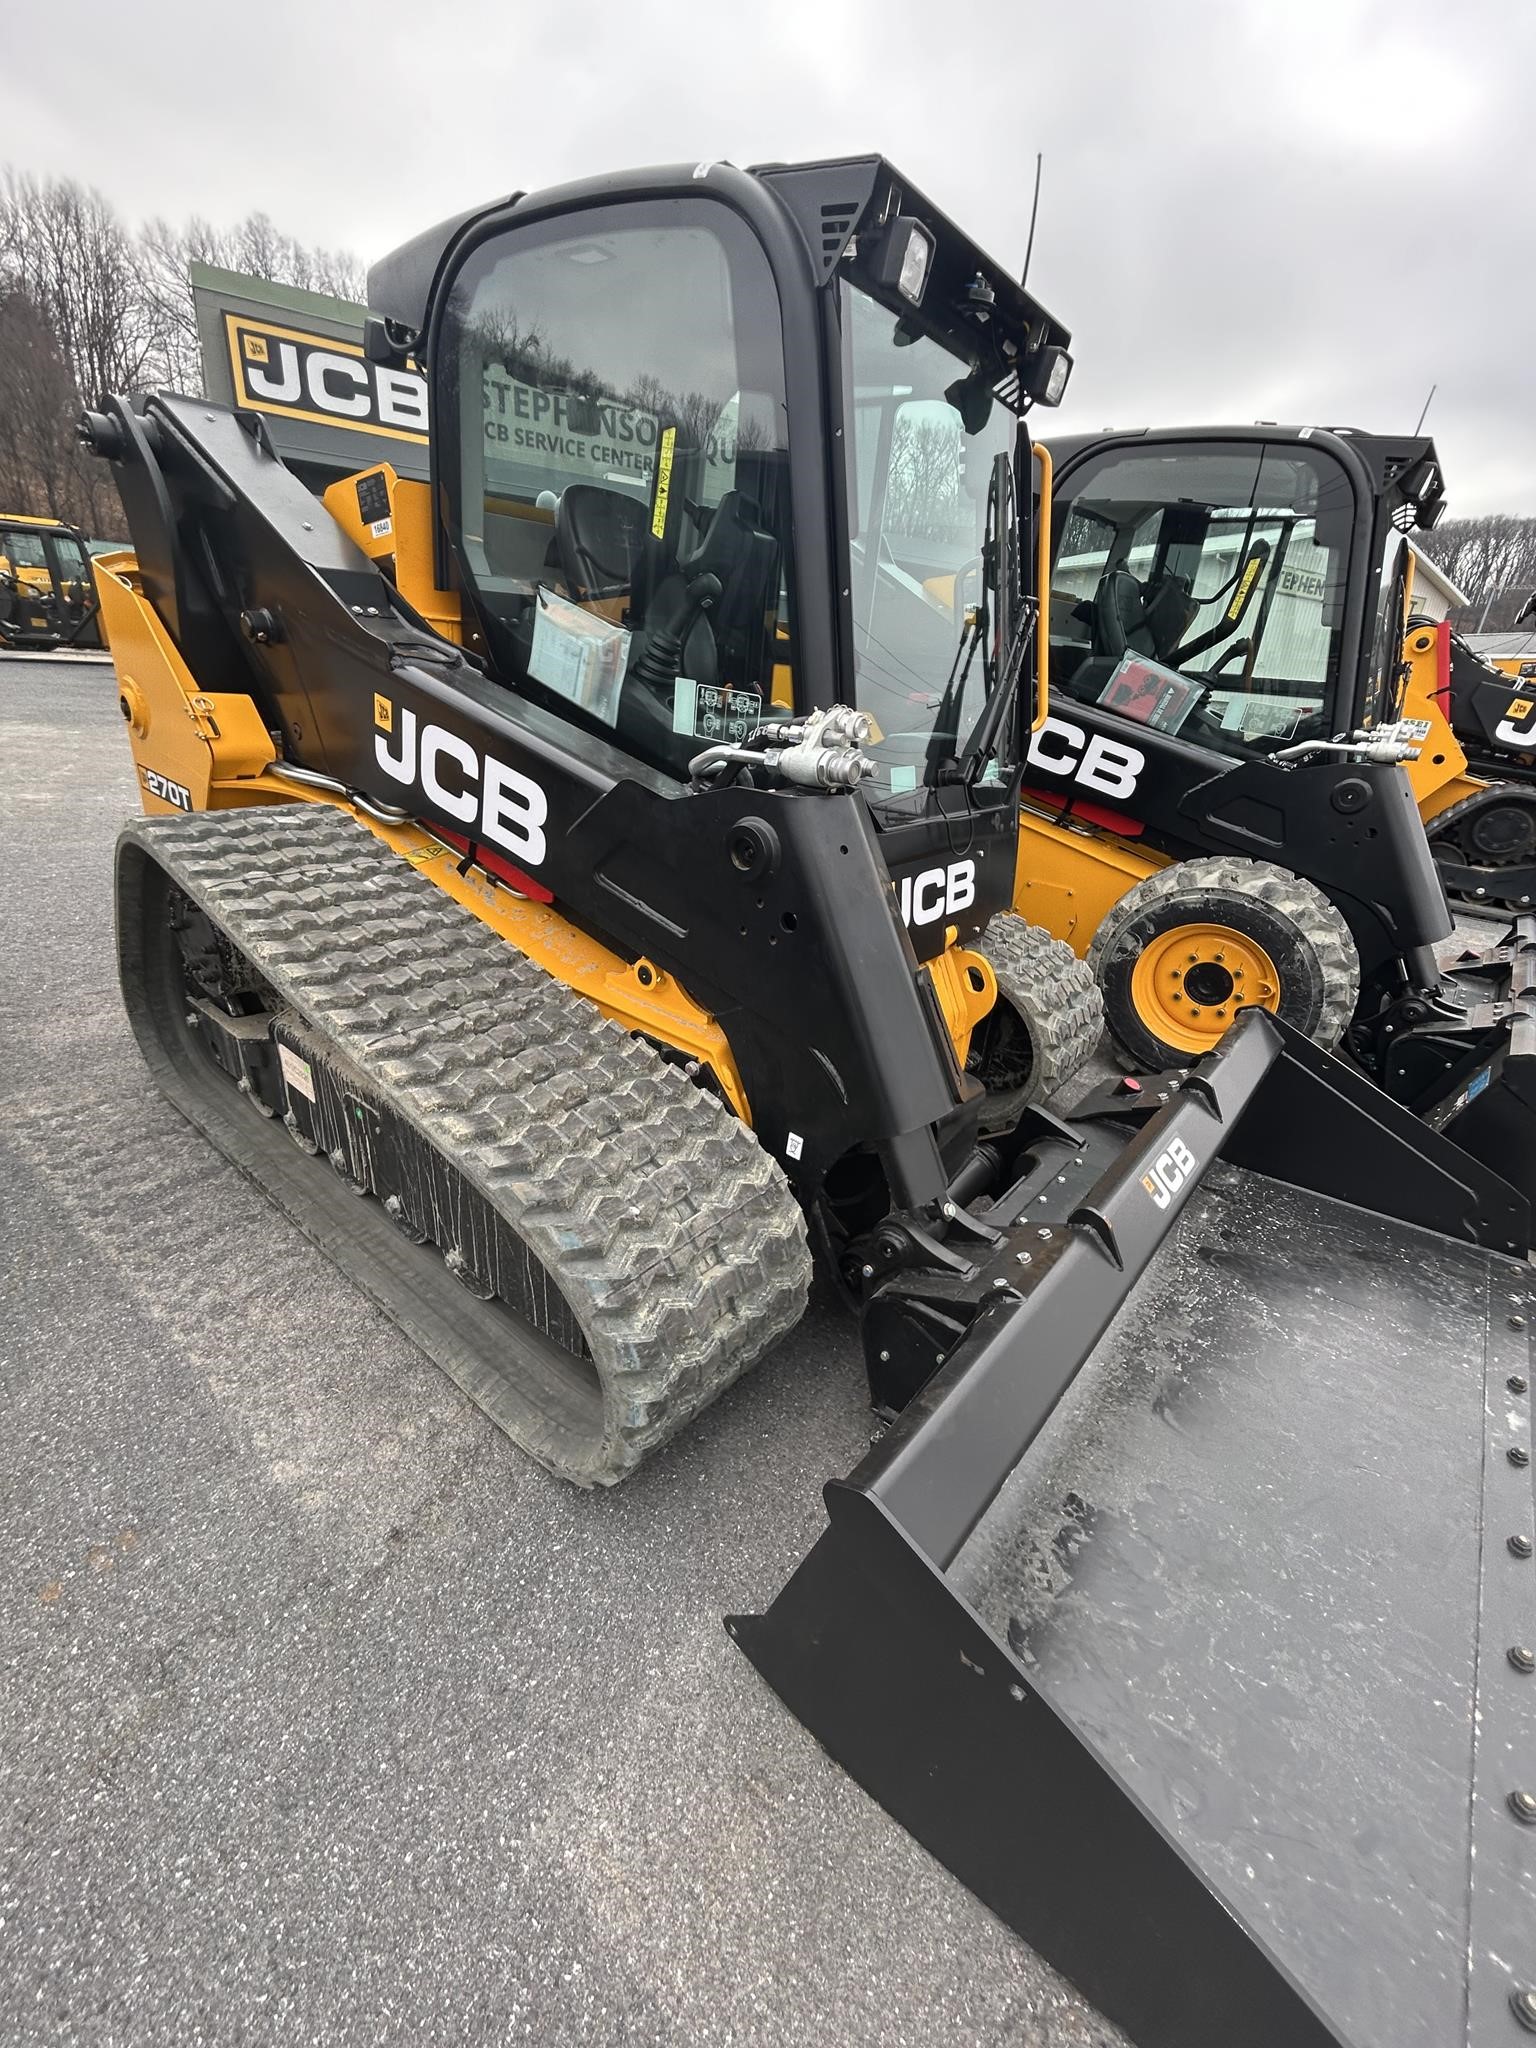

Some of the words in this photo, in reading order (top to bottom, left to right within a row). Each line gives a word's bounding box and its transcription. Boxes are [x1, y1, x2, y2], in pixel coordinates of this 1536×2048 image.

[247, 342, 430, 431] JCB
[484, 421, 510, 443] CB
[514, 427, 586, 459] SERVICE
[590, 444, 655, 472] CENTER
[147, 770, 190, 811] 270T
[374, 707, 548, 866] JCB
[1026, 716, 1146, 800] CB
[1148, 1137, 1196, 1210] JCB
